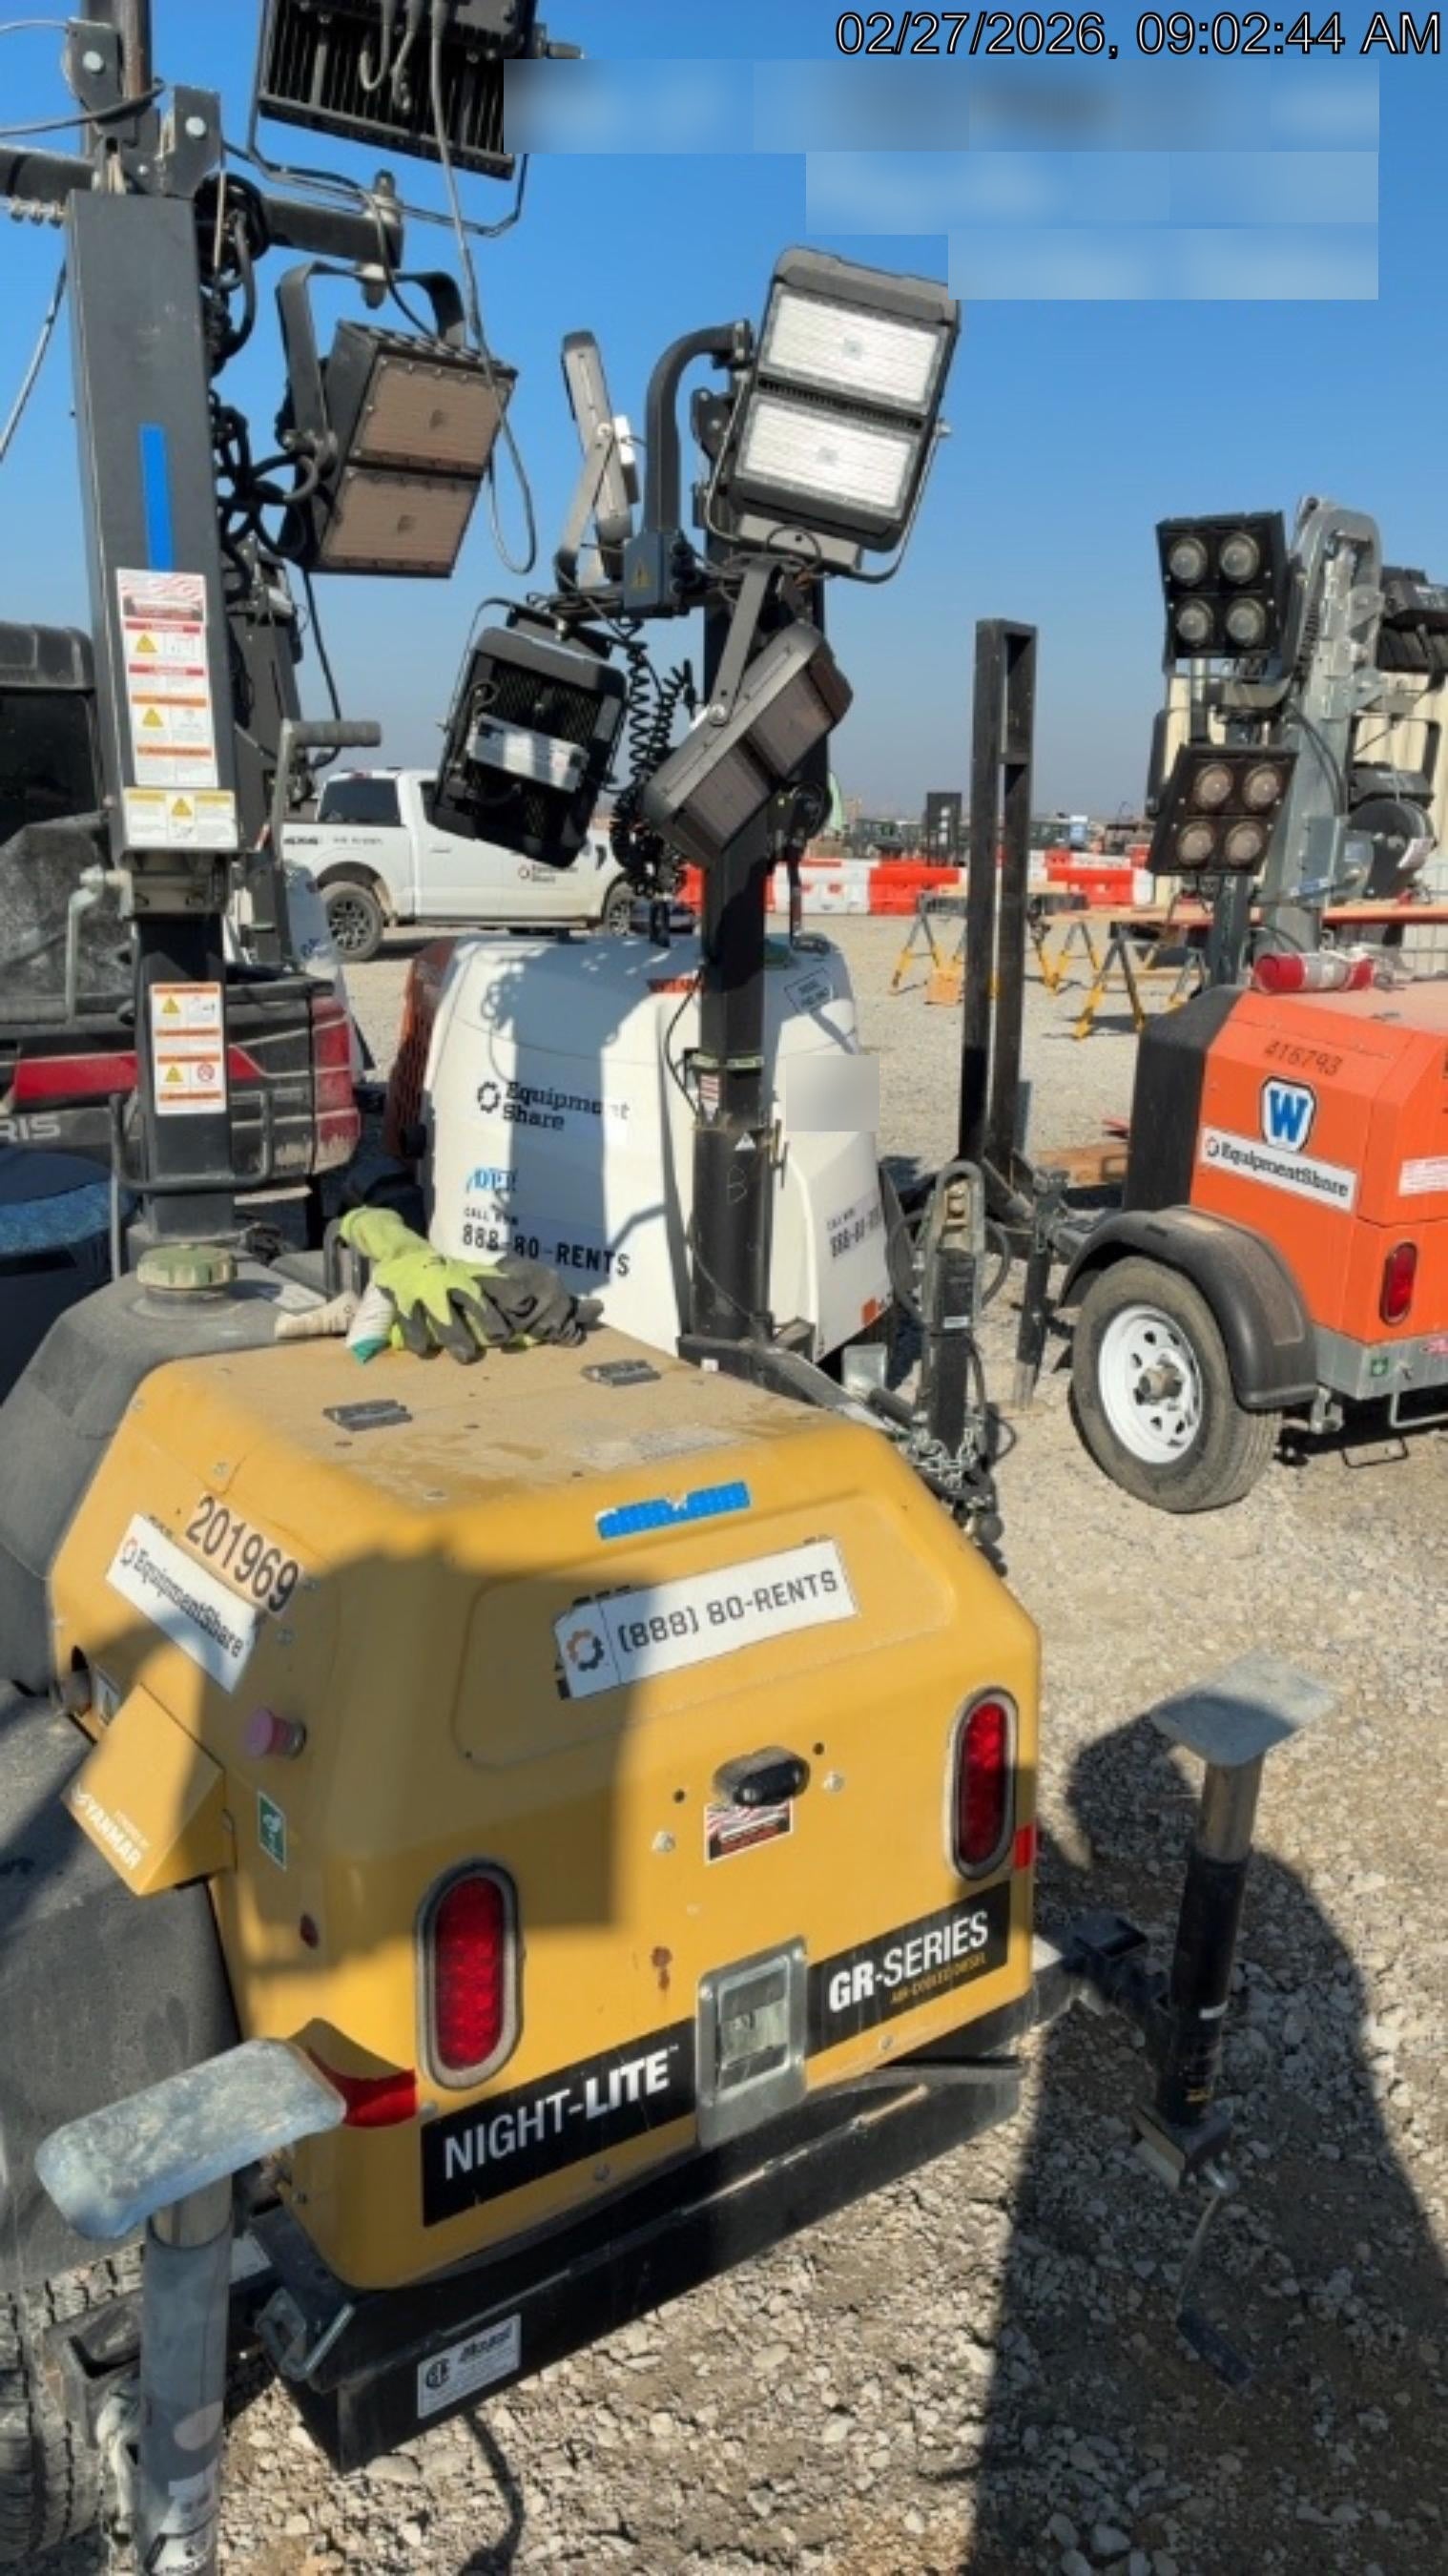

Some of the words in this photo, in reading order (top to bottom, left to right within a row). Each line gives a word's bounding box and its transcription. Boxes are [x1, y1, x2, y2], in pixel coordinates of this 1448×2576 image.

[503, 1103, 565, 1131] Share
[1270, 1090, 1309, 1142] W
[1221, 1142, 1349, 1197] EquipmentShare
[185, 1494, 300, 1612] 201969
[134, 1548, 244, 1658] EquipmentShare
[618, 1605, 699, 1652] (888)
[706, 1569, 838, 1627] 80-RENTS
[828, 1910, 989, 2013] GR-SERIES
